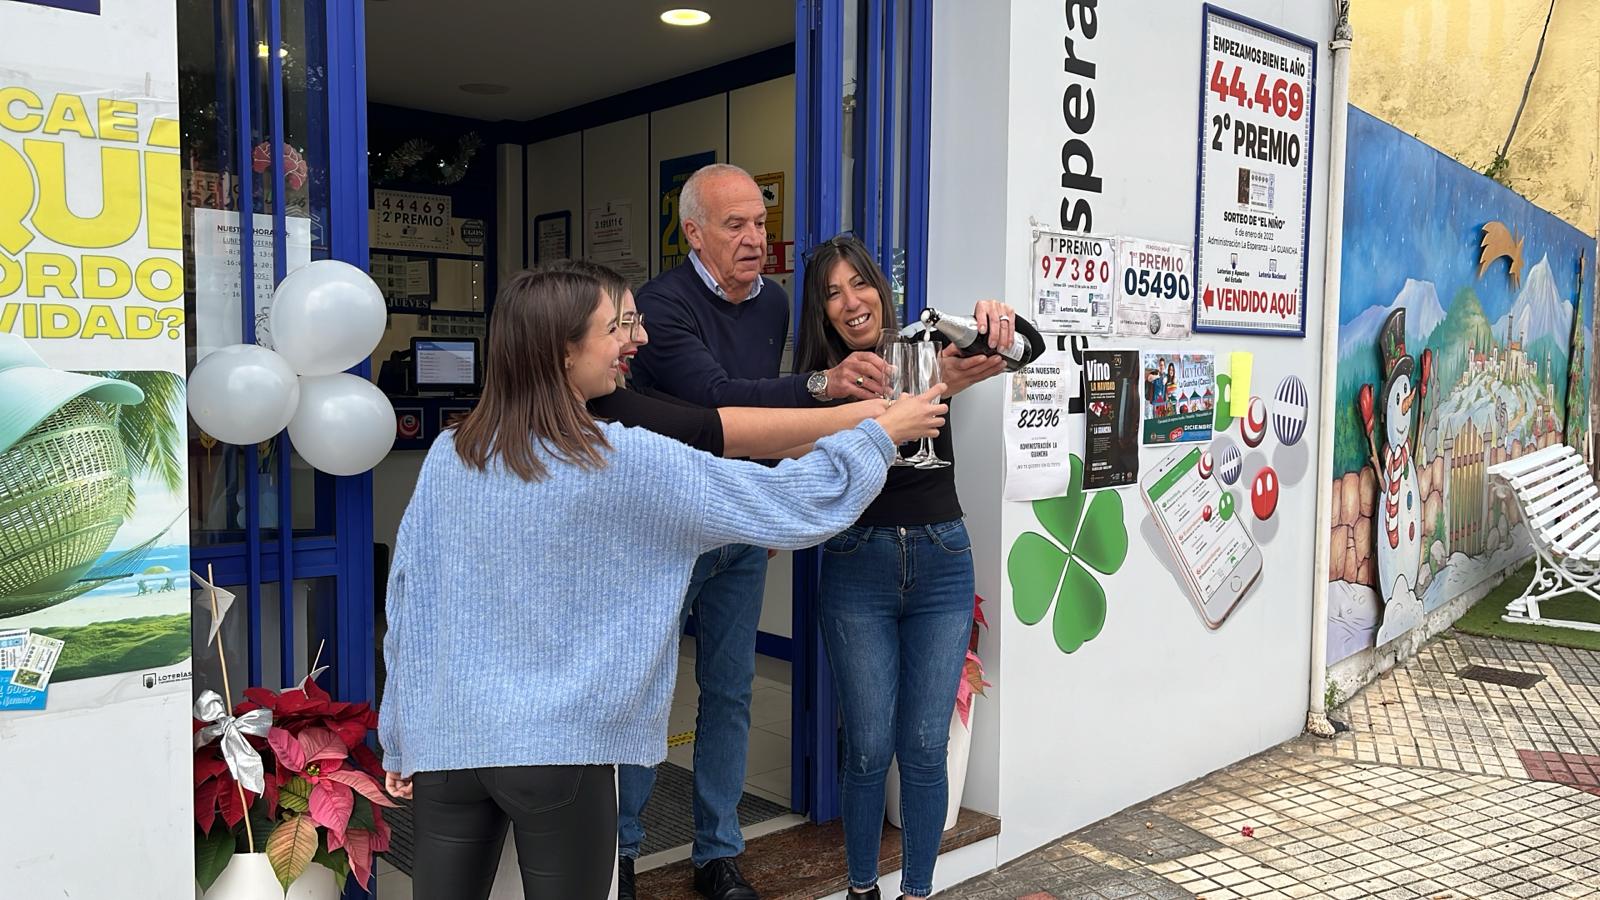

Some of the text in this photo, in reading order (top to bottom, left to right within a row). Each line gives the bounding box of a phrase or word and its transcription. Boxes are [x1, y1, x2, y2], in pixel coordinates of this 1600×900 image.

[1213, 35, 1305, 77] EMPEZAMOS BIEN EL AÑO
[1210, 60, 1304, 121] 44.469
[0, 86, 139, 143] CAE
[1212, 113, 1300, 167] 2º PREMIO
[395, 213, 444, 227] PREMIO
[1223, 211, 1249, 225] SORTEO
[1248, 215, 1257, 226] DE
[1234, 228, 1238, 236] 6
[1258, 231, 1263, 239] de
[1263, 232, 1274, 241] 2022
[1060, 238, 1102, 257] PREMIO
[1207, 236, 1298, 255] Administración La Esperanza LA GUANCHA
[1041, 255, 1109, 283] 97380
[1139, 252, 1184, 273] PREMIO
[1124, 267, 1190, 300] 05490
[1271, 272, 1286, 280] Nacional
[388, 297, 430, 309] JUEVES
[1216, 287, 1298, 319] VENDIDO AQUÍ
[1035, 367, 1060, 375] NUESTRO
[1086, 359, 1111, 381] Vino
[1025, 378, 1057, 388] NÚMERO DE
[1026, 393, 1052, 401] NAVIDAD
[1017, 408, 1060, 429] 82396
[1020, 441, 1051, 450] ADMINISTRACIÓN
[158, 672, 192, 682] LOTERÍAS
